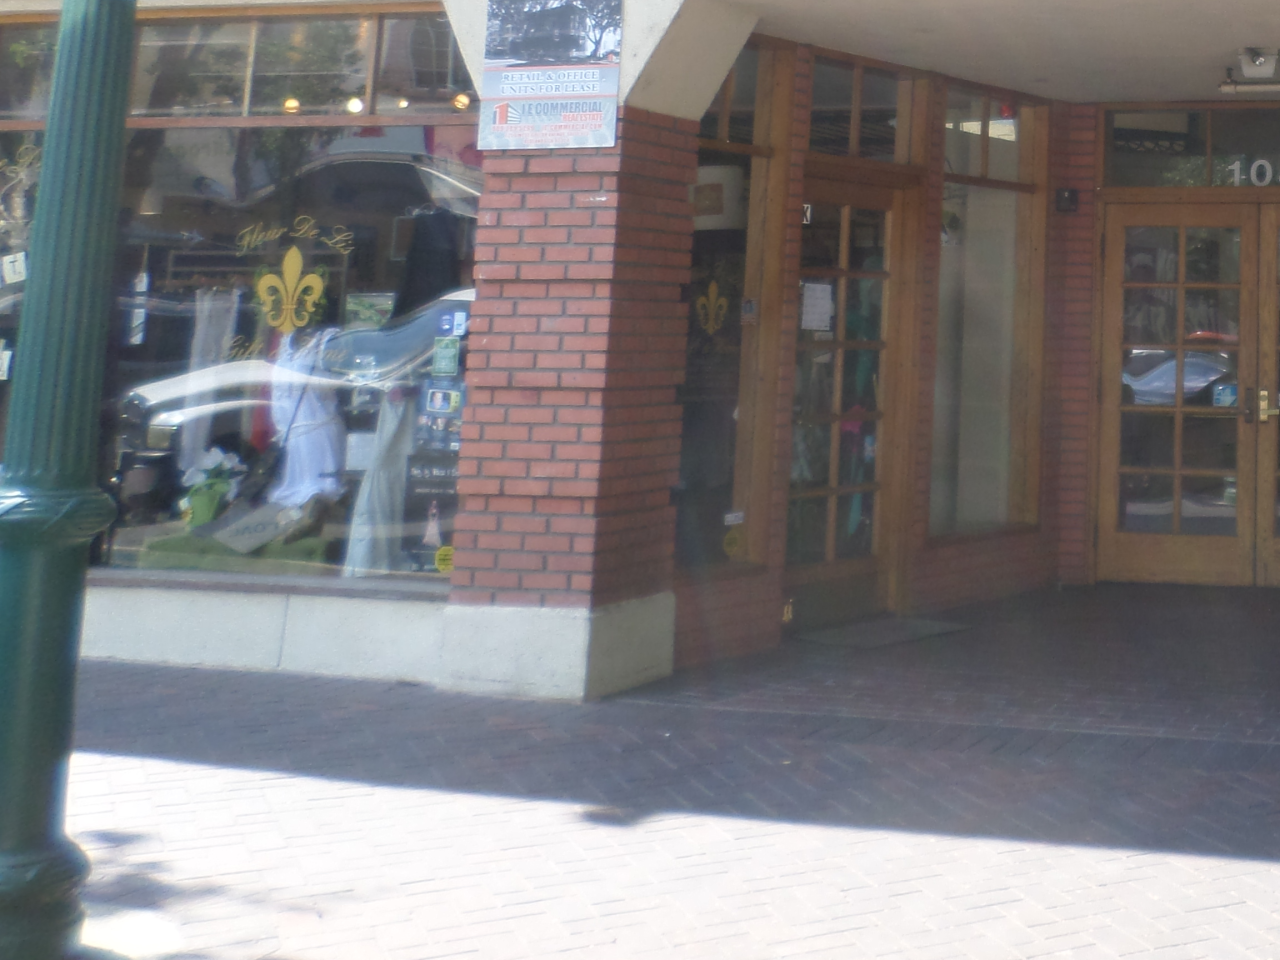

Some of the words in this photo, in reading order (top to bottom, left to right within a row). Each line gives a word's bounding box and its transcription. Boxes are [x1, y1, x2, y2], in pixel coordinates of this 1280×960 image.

[501, 72, 542, 82] RETAIL
[546, 71, 556, 81] &
[557, 70, 600, 80] OFFICE
[501, 84, 536, 95] UNITS
[539, 83, 561, 93] FOR
[564, 82, 599, 92] LEASE
[535, 100, 603, 116] COMMERCIAL
[235, 221, 288, 258] Fleur
[289, 215, 320, 239] De
[320, 224, 355, 255] Lis
